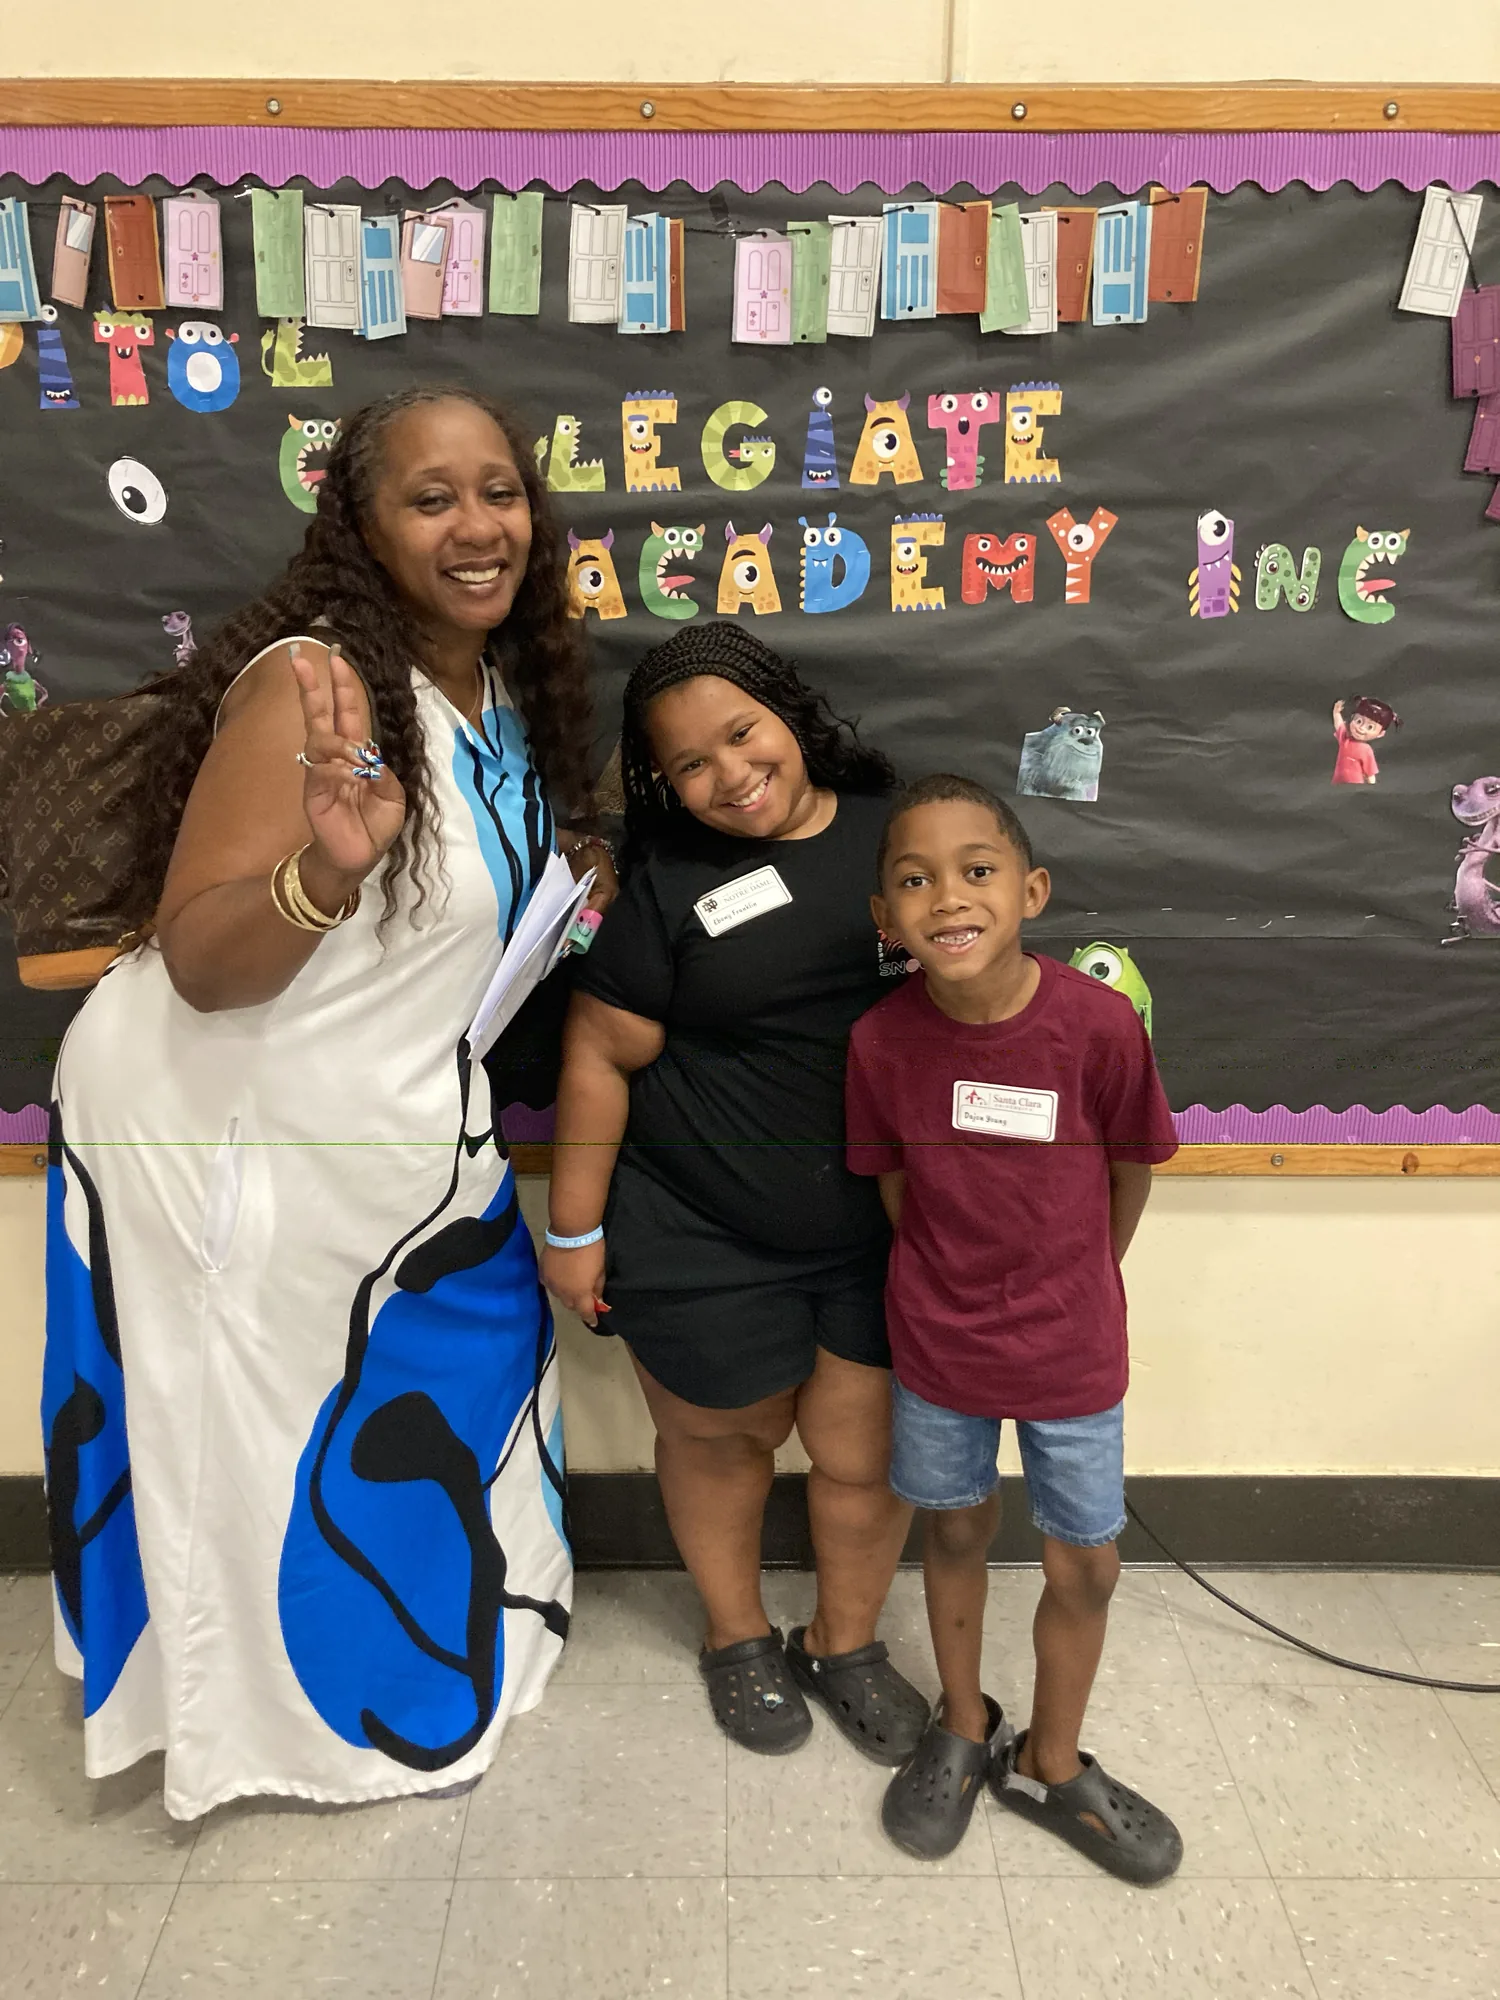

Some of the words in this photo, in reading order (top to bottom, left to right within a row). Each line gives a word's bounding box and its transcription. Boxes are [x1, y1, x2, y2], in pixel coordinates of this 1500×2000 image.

[0, 303, 334, 413] ITOL
[279, 381, 1063, 514] CLEGIATE
[567, 506, 1118, 620] ACADEMY
[1188, 509, 1410, 624] INC
[993, 1094, 1016, 1105] Santa
[1018, 1097, 1042, 1109] Clara
